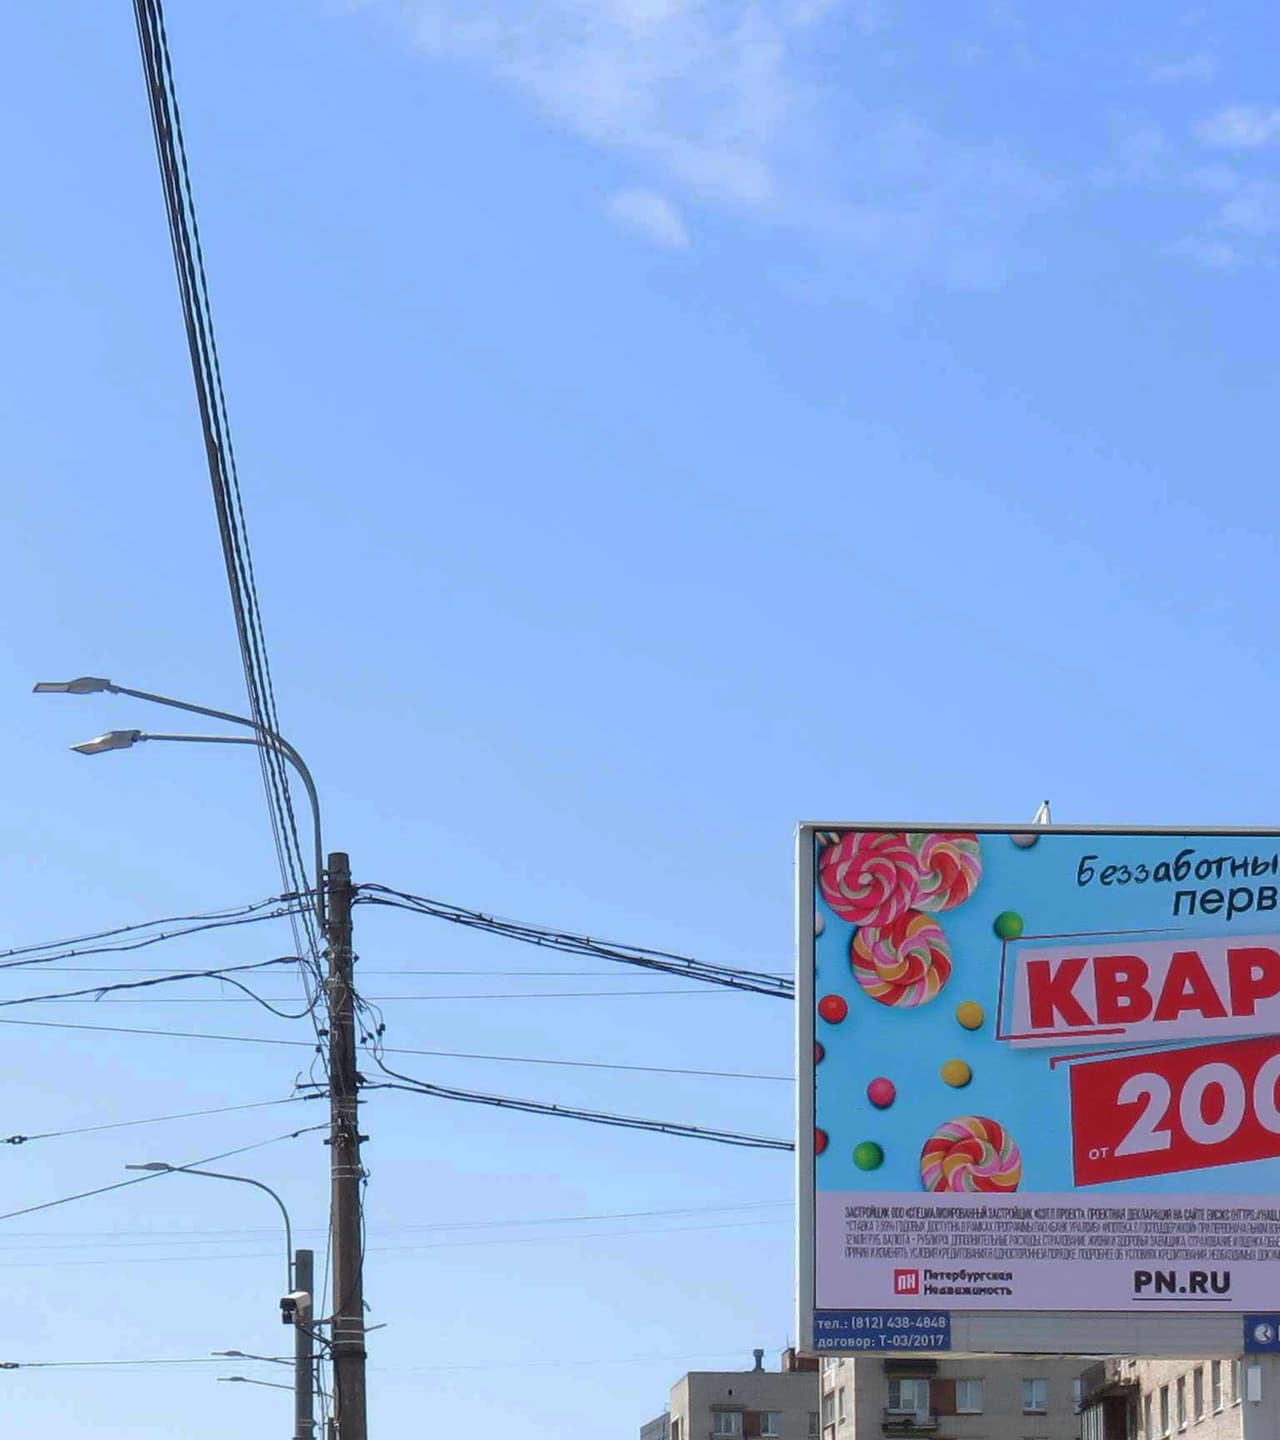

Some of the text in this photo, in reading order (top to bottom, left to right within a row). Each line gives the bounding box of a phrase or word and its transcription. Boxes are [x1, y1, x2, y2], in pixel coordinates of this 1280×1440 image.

[1088, 1145, 1110, 1160] от
[923, 1269, 1013, 1283] Петербургская
[1133, 1270, 1231, 1294] PN.RU
[923, 1284, 1013, 1296] Недвижимость
[816, 1316, 946, 1329] тел.: (812) 438-4848
[816, 1337, 875, 1349] договор:
